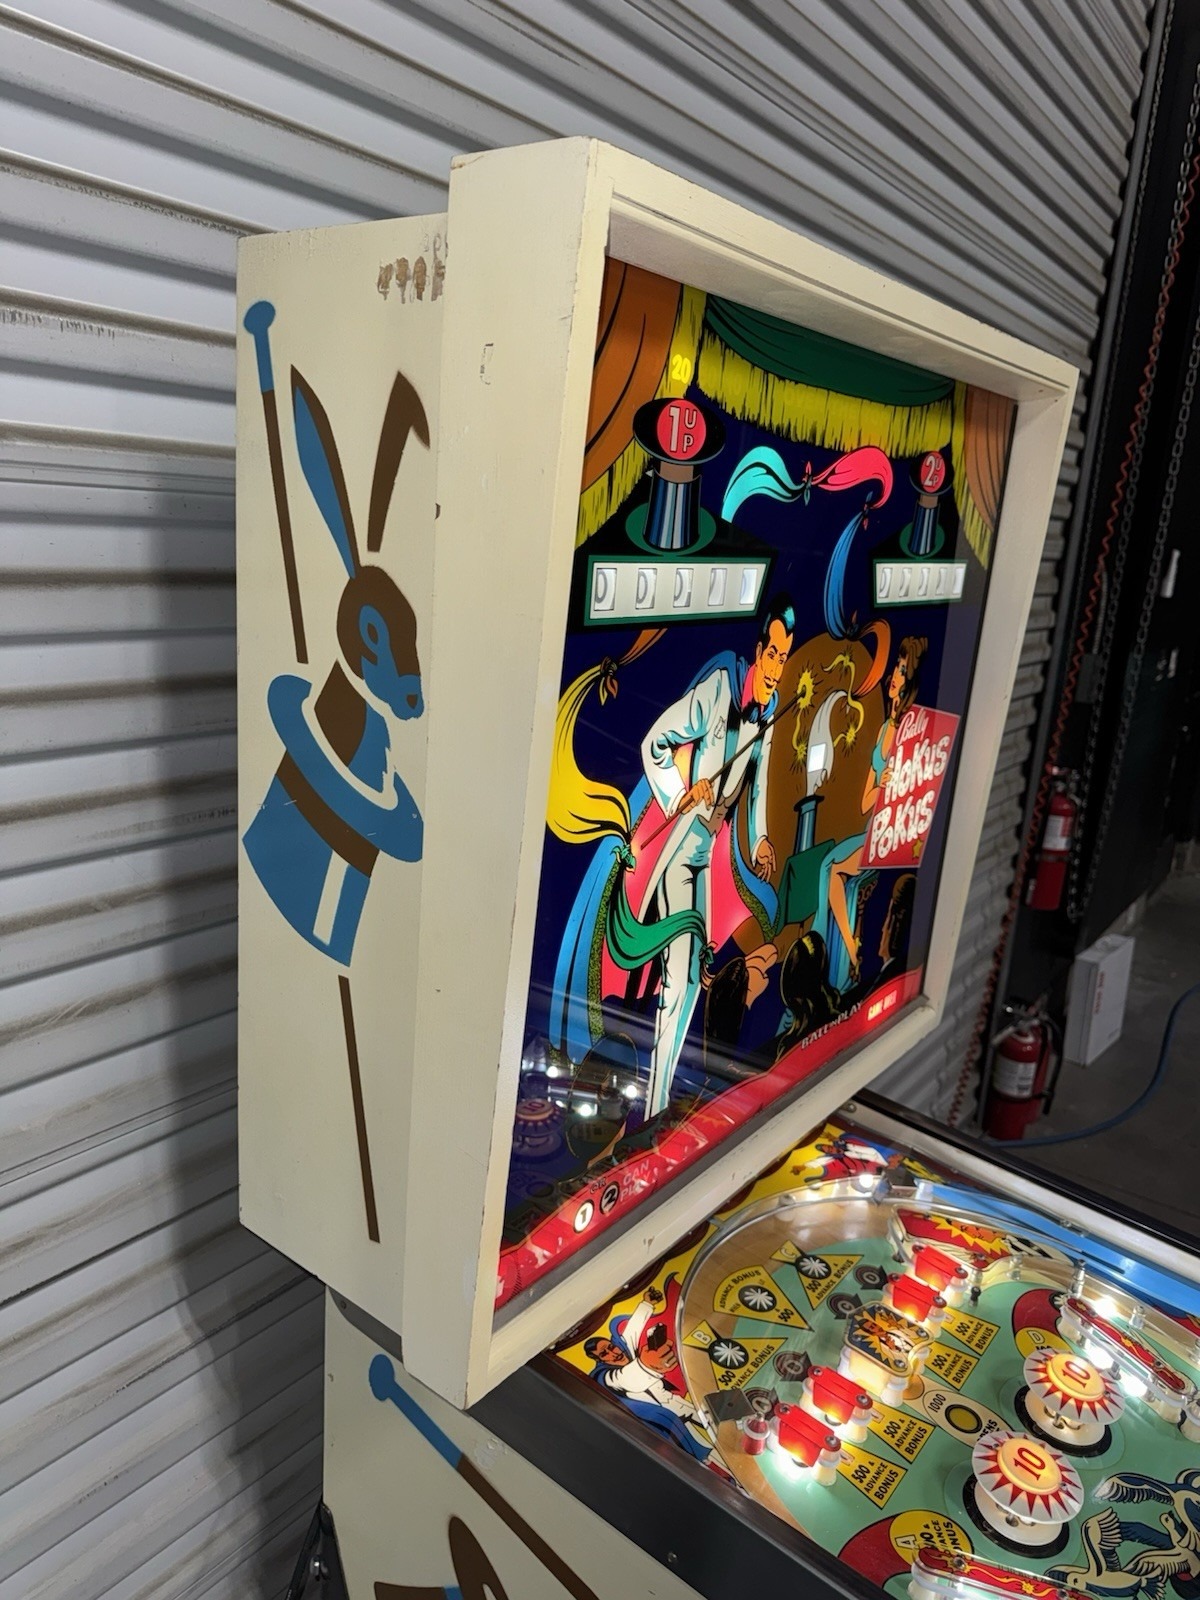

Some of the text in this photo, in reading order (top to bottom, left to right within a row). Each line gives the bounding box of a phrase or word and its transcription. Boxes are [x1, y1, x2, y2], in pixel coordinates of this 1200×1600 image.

[671, 354, 691, 384] 20
[896, 708, 929, 746] Bally
[623, 1160, 649, 1185] CAN
[603, 1188, 616, 1208] 2
[731, 1270, 761, 1284] BONUS
[806, 1280, 821, 1293] 500
[816, 1260, 854, 1300] ADVANCE BONUS
[778, 1308, 794, 1322] 500
[691, 1330, 712, 1345] B
[955, 1322, 971, 1336] 500
[965, 1322, 984, 1344] ADVANCE
[975, 1327, 994, 1350] BONUS
[1027, 1329, 1045, 1344] D
[731, 1344, 775, 1390] DVANCE BONUS
[932, 1354, 948, 1370] 500
[943, 1353, 962, 1378] ADVANCE
[952, 1360, 973, 1384] BONUS
[718, 1370, 736, 1386] 500
[1062, 1360, 1091, 1389] 10
[928, 1393, 946, 1413] 1000
[883, 1420, 901, 1439] 500
[894, 1420, 917, 1449] ADVANCE
[905, 1426, 928, 1455] BONUS
[851, 1464, 871, 1484] 500
[1014, 1446, 1046, 1481] 10
[864, 1462, 888, 1493] ADVANCE
[874, 1469, 899, 1500] BONUS
[895, 1534, 918, 1549] A
